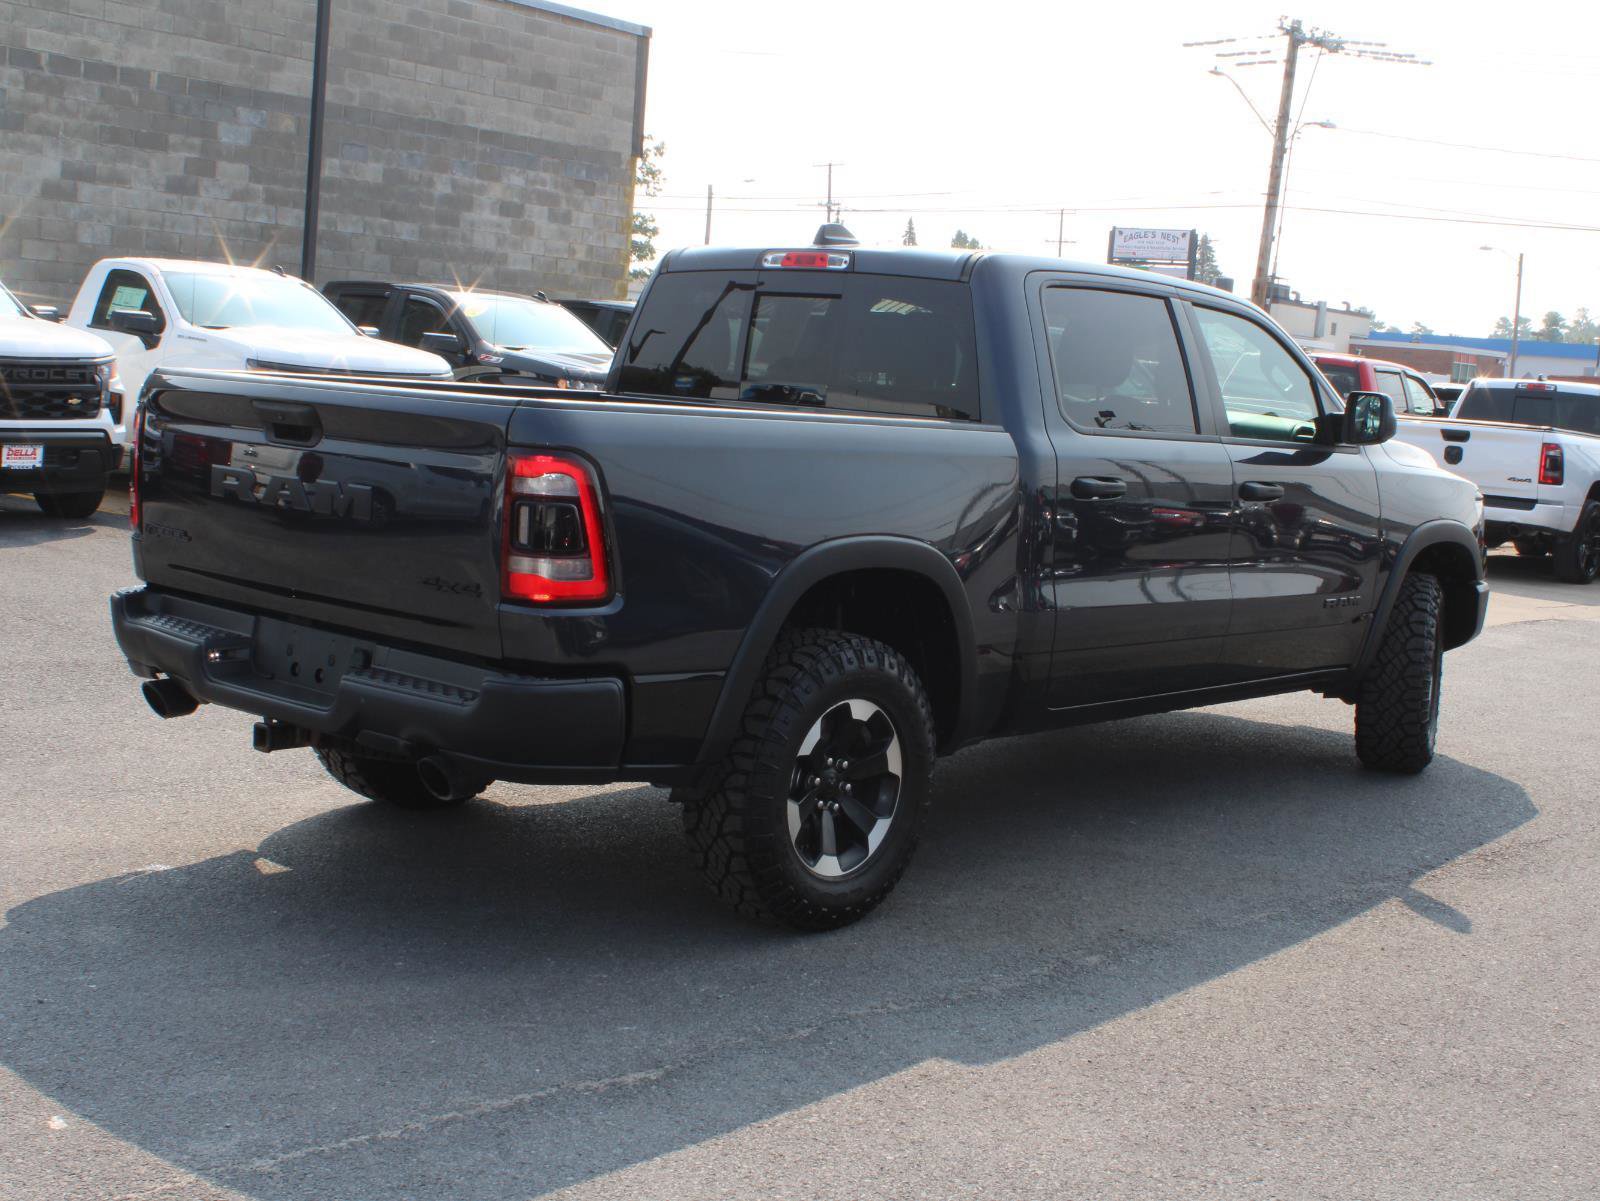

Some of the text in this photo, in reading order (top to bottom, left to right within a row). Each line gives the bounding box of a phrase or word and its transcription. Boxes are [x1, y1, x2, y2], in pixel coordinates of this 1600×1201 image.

[1123, 230, 1179, 245] EAGLE'S NEST
[6, 447, 37, 457] DELLA
[211, 463, 373, 520] RAM
